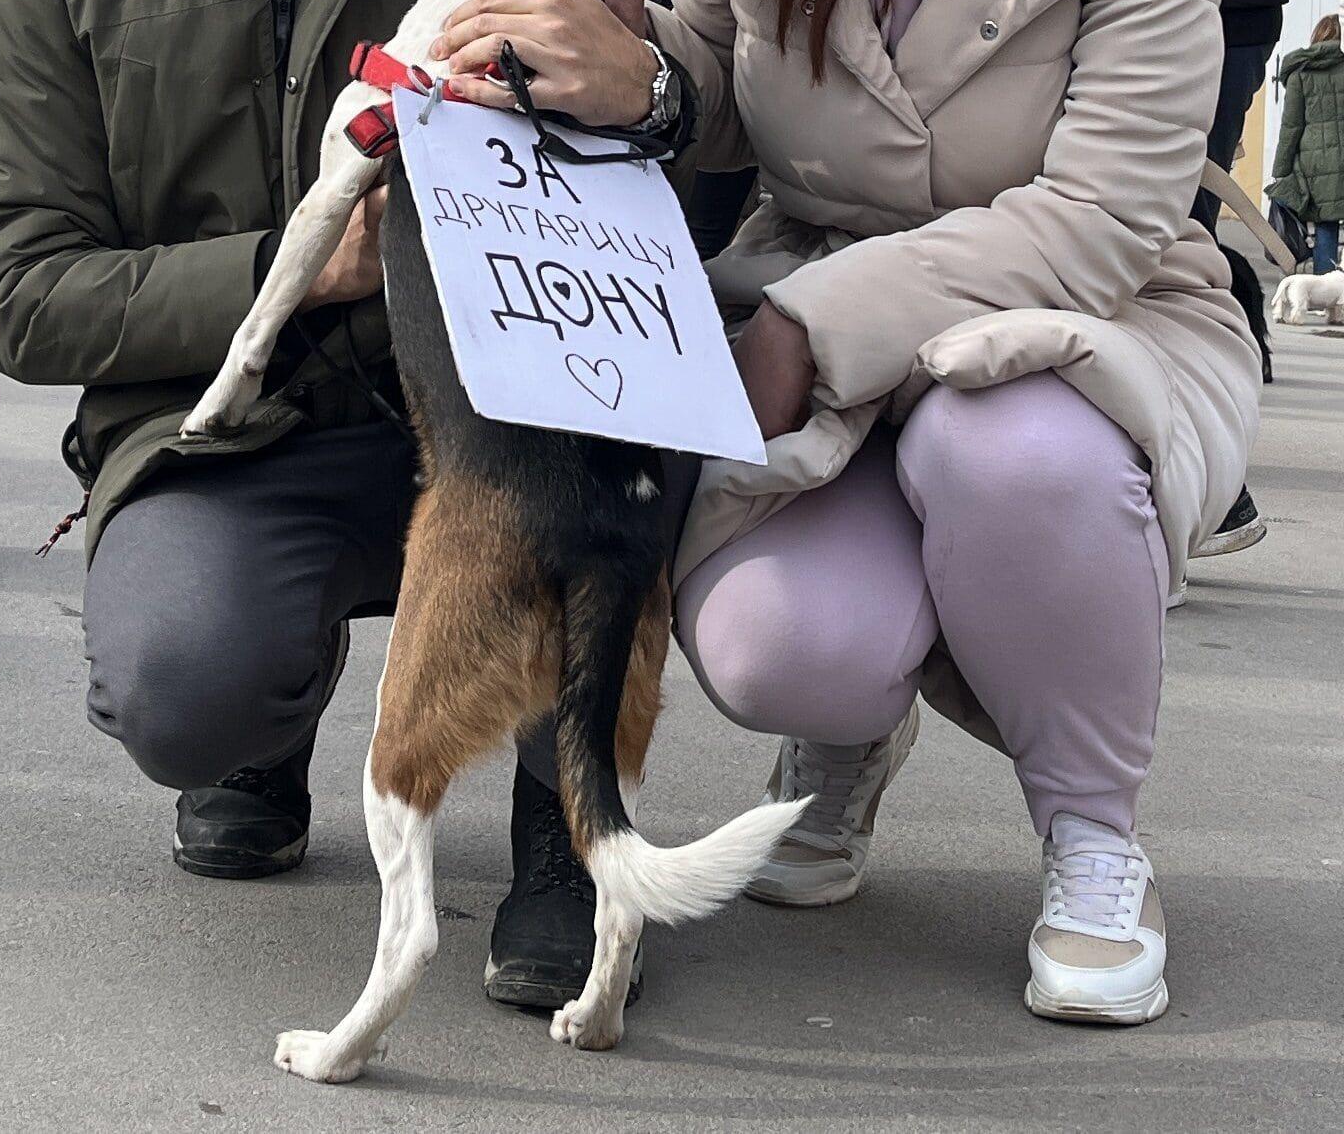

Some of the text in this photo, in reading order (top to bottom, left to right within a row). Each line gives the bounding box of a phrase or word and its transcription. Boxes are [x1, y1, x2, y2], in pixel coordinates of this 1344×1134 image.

[485, 137, 582, 204] ЗА
[432, 186, 675, 276] ДРУГАРИЦУ
[484, 251, 683, 356] ДОНУ
